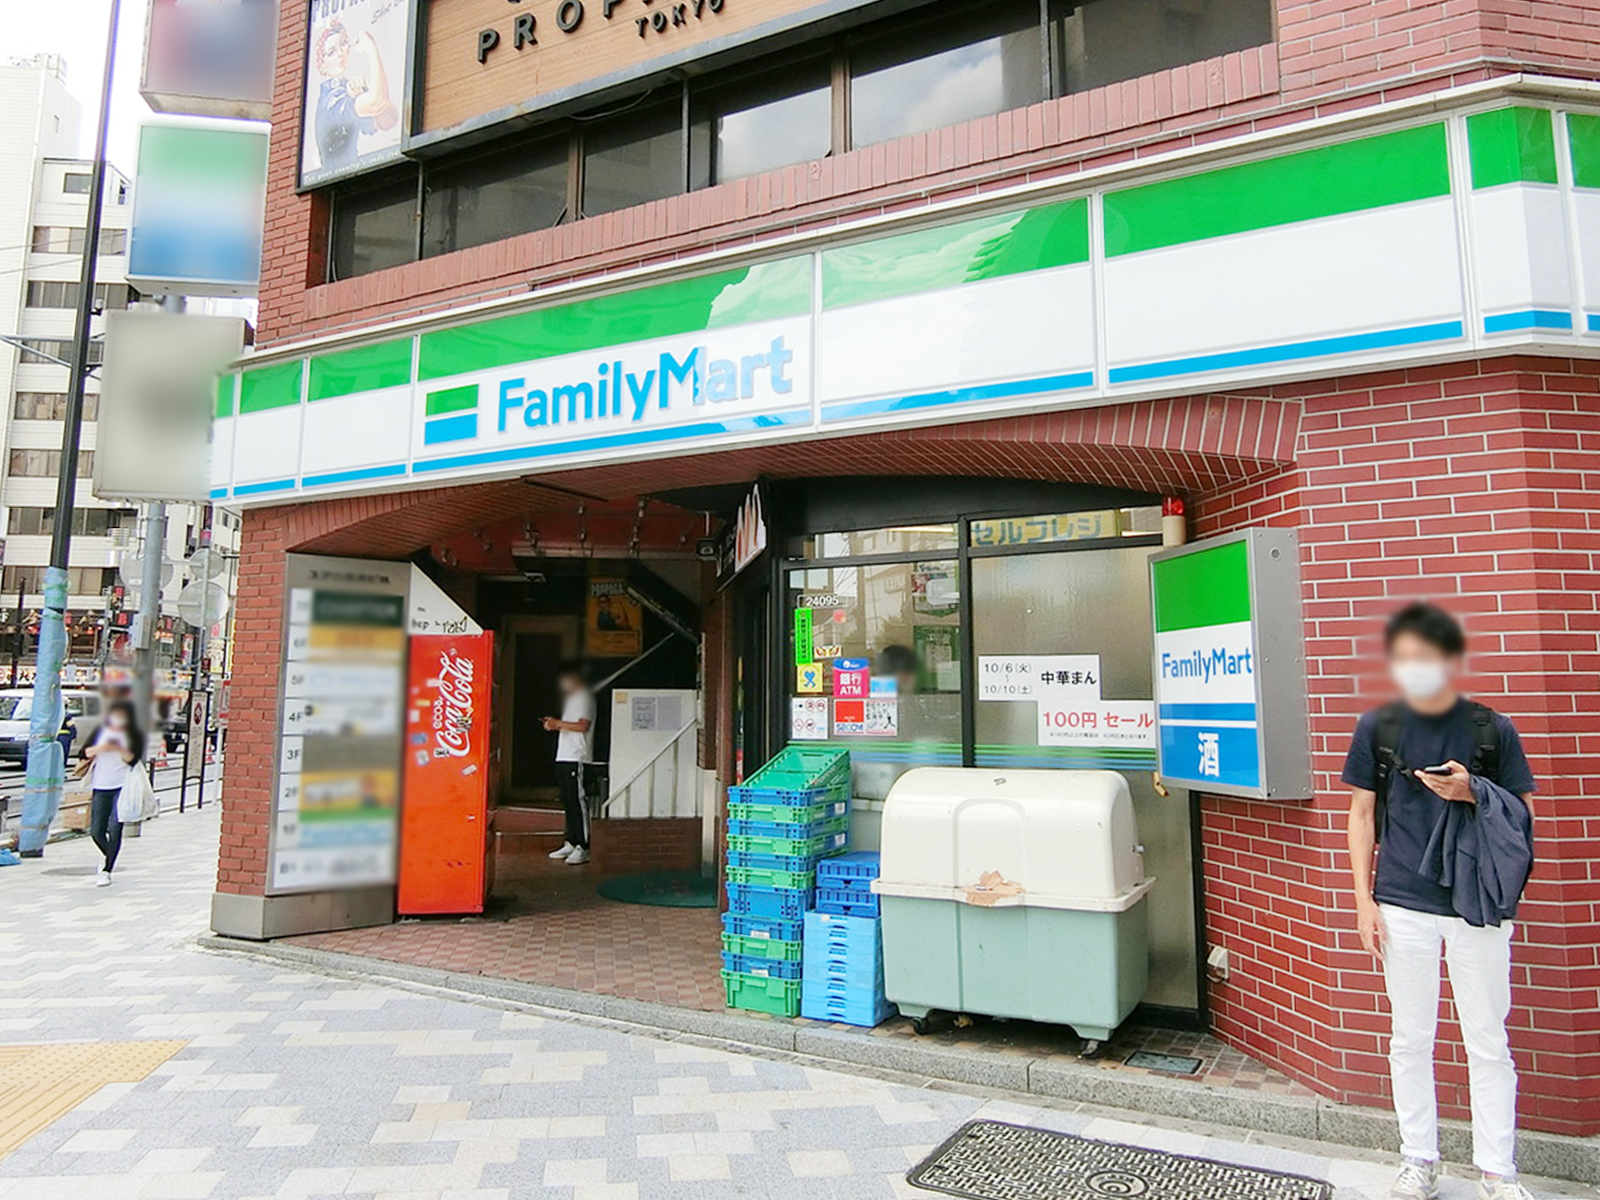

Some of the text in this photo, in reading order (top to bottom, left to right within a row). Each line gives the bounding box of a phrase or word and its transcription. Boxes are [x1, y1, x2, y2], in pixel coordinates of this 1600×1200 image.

[636, 0, 724, 38] TOKYO
[478, 0, 650, 64] PROP
[499, 335, 793, 432] FamilyMart
[806, 595, 839, 607] 24095
[1162, 647, 1252, 684] FamilyMart
[840, 673, 862, 685] 銀行
[1041, 670, 1098, 686] 中華まん
[839, 686, 862, 695] ATM
[288, 711, 303, 722] 4F
[1043, 711, 1154, 729] 100円 セール
[287, 749, 301, 761] 3F
[1198, 732, 1220, 777] 酒
